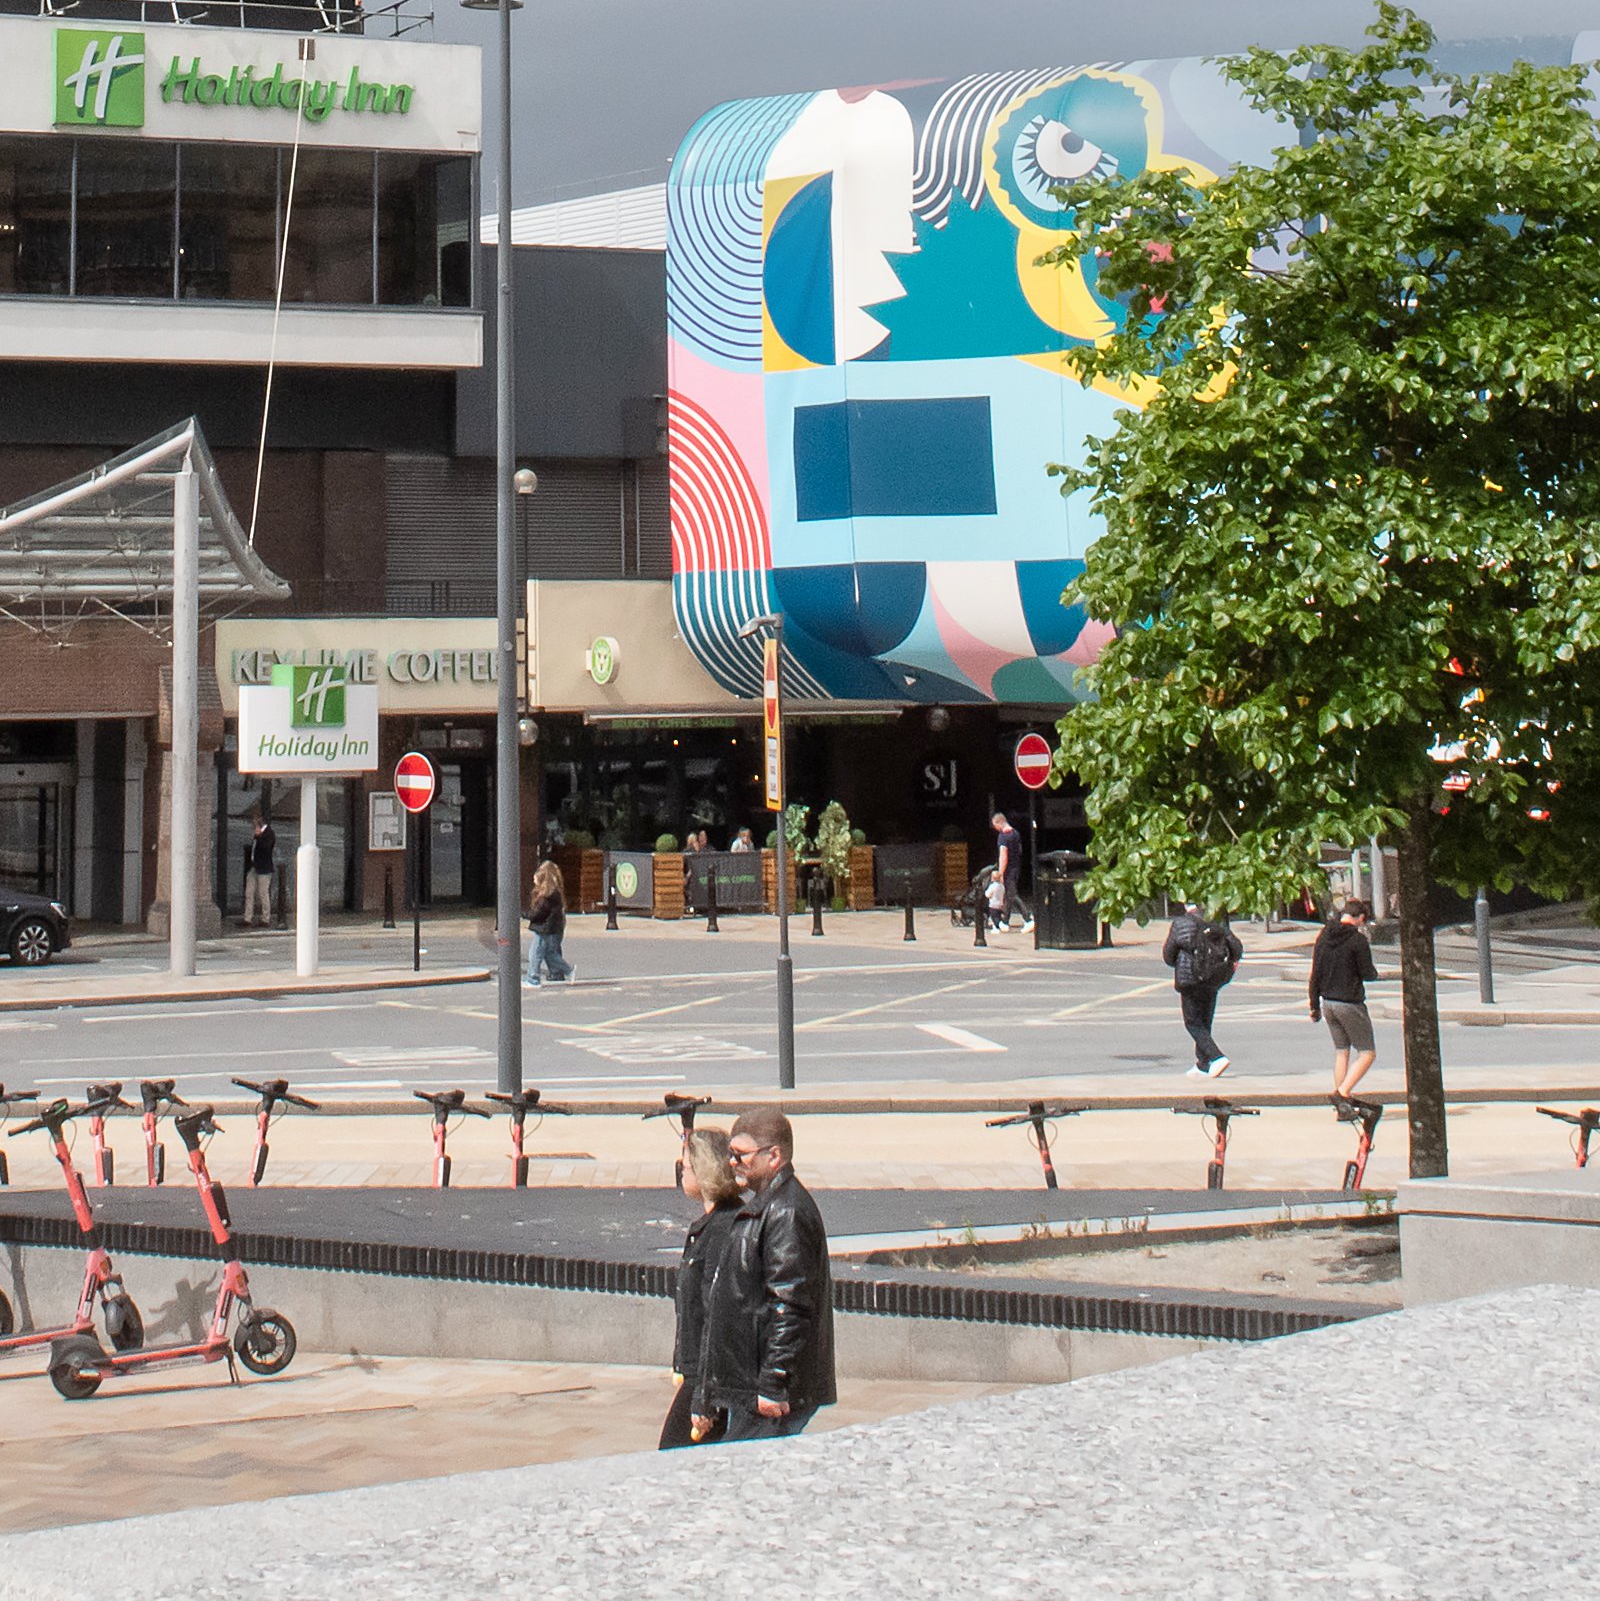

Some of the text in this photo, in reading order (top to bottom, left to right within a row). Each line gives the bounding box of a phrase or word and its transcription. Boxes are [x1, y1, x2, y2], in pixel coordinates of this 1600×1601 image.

[160, 55, 415, 122] Holiday Inn
[257, 733, 369, 761] Holiday Inn
